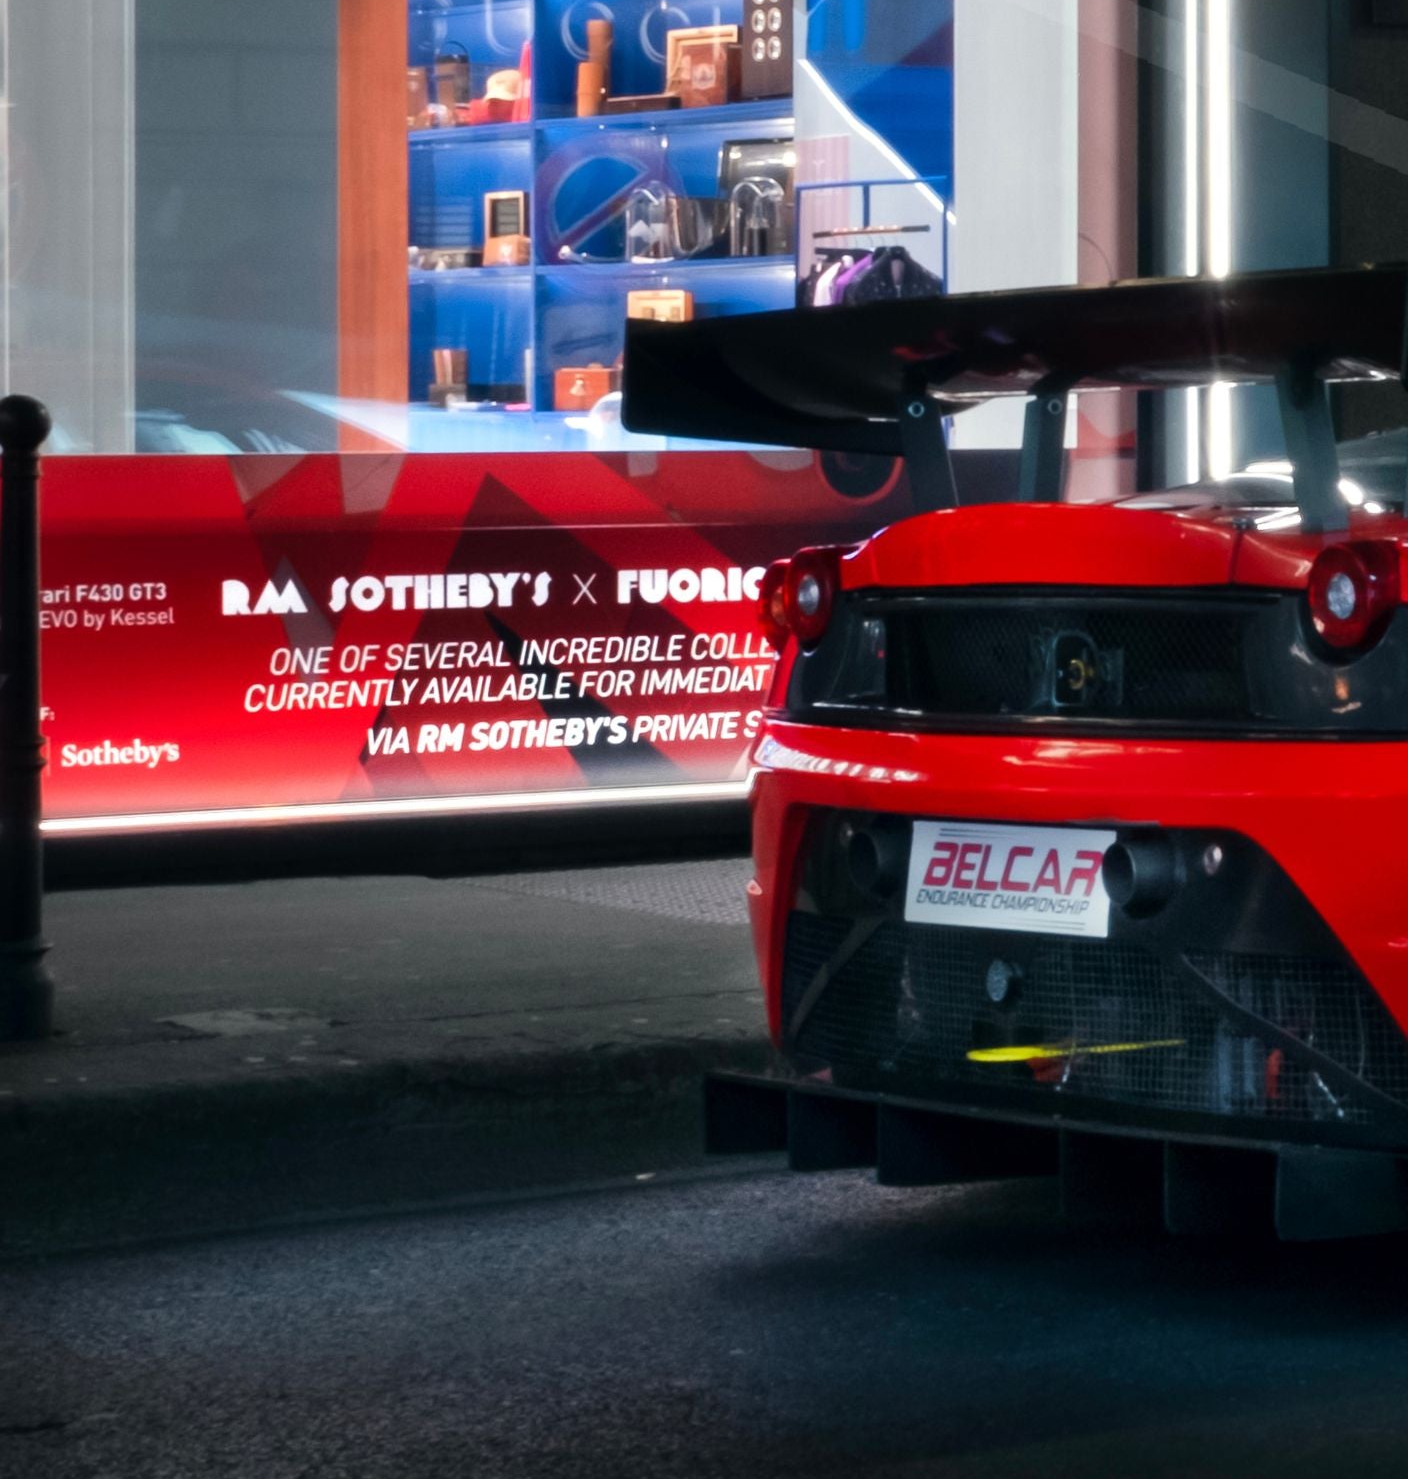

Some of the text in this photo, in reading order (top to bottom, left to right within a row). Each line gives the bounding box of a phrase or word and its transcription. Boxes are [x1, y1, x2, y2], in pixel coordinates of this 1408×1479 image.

[76, 584, 124, 603] F430
[129, 582, 168, 601] GT3
[222, 578, 308, 616] RM
[328, 571, 553, 613] SOTHEBY'S
[83, 607, 105, 631] by
[110, 606, 175, 626] Kessel
[270, 646, 334, 676] ONE
[339, 644, 383, 673] OF
[384, 640, 512, 672] SEVERAL
[519, 634, 686, 667] INCREDIBLE
[244, 677, 419, 713] CURRENTLY
[420, 671, 571, 705] AVAILABLE
[578, 669, 636, 699] FOR
[61, 738, 181, 769] Sotheby's
[367, 726, 411, 756] VIA
[416, 721, 468, 753] RM
[467, 714, 628, 751] SOTHEBY'S
[632, 711, 742, 744] PRIVATE
[922, 840, 1103, 897] BELCAR
[916, 887, 1090, 915] ENDURANCE CHAMPIONSHIP
